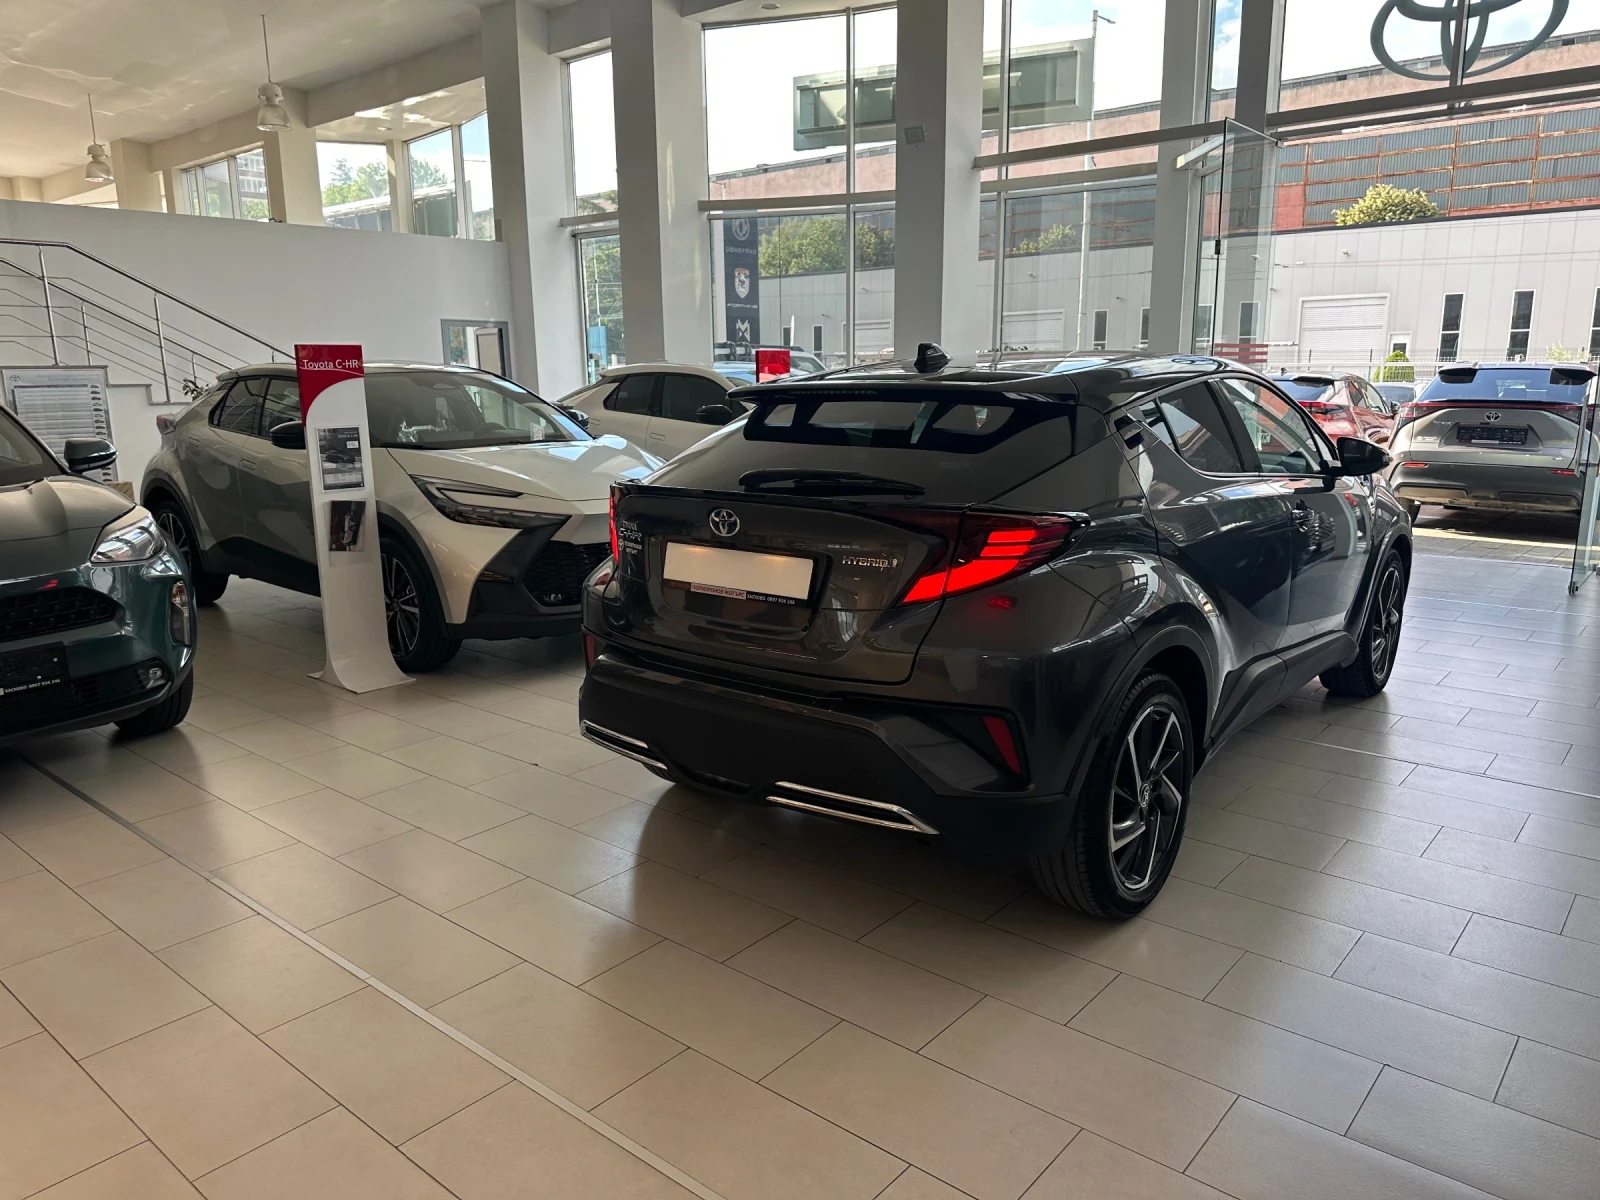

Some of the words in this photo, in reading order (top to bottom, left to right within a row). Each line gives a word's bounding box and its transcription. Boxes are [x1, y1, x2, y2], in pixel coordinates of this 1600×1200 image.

[302, 359, 334, 370] Toyota
[335, 359, 359, 369] C-HR
[842, 555, 888, 568] HYBRID
